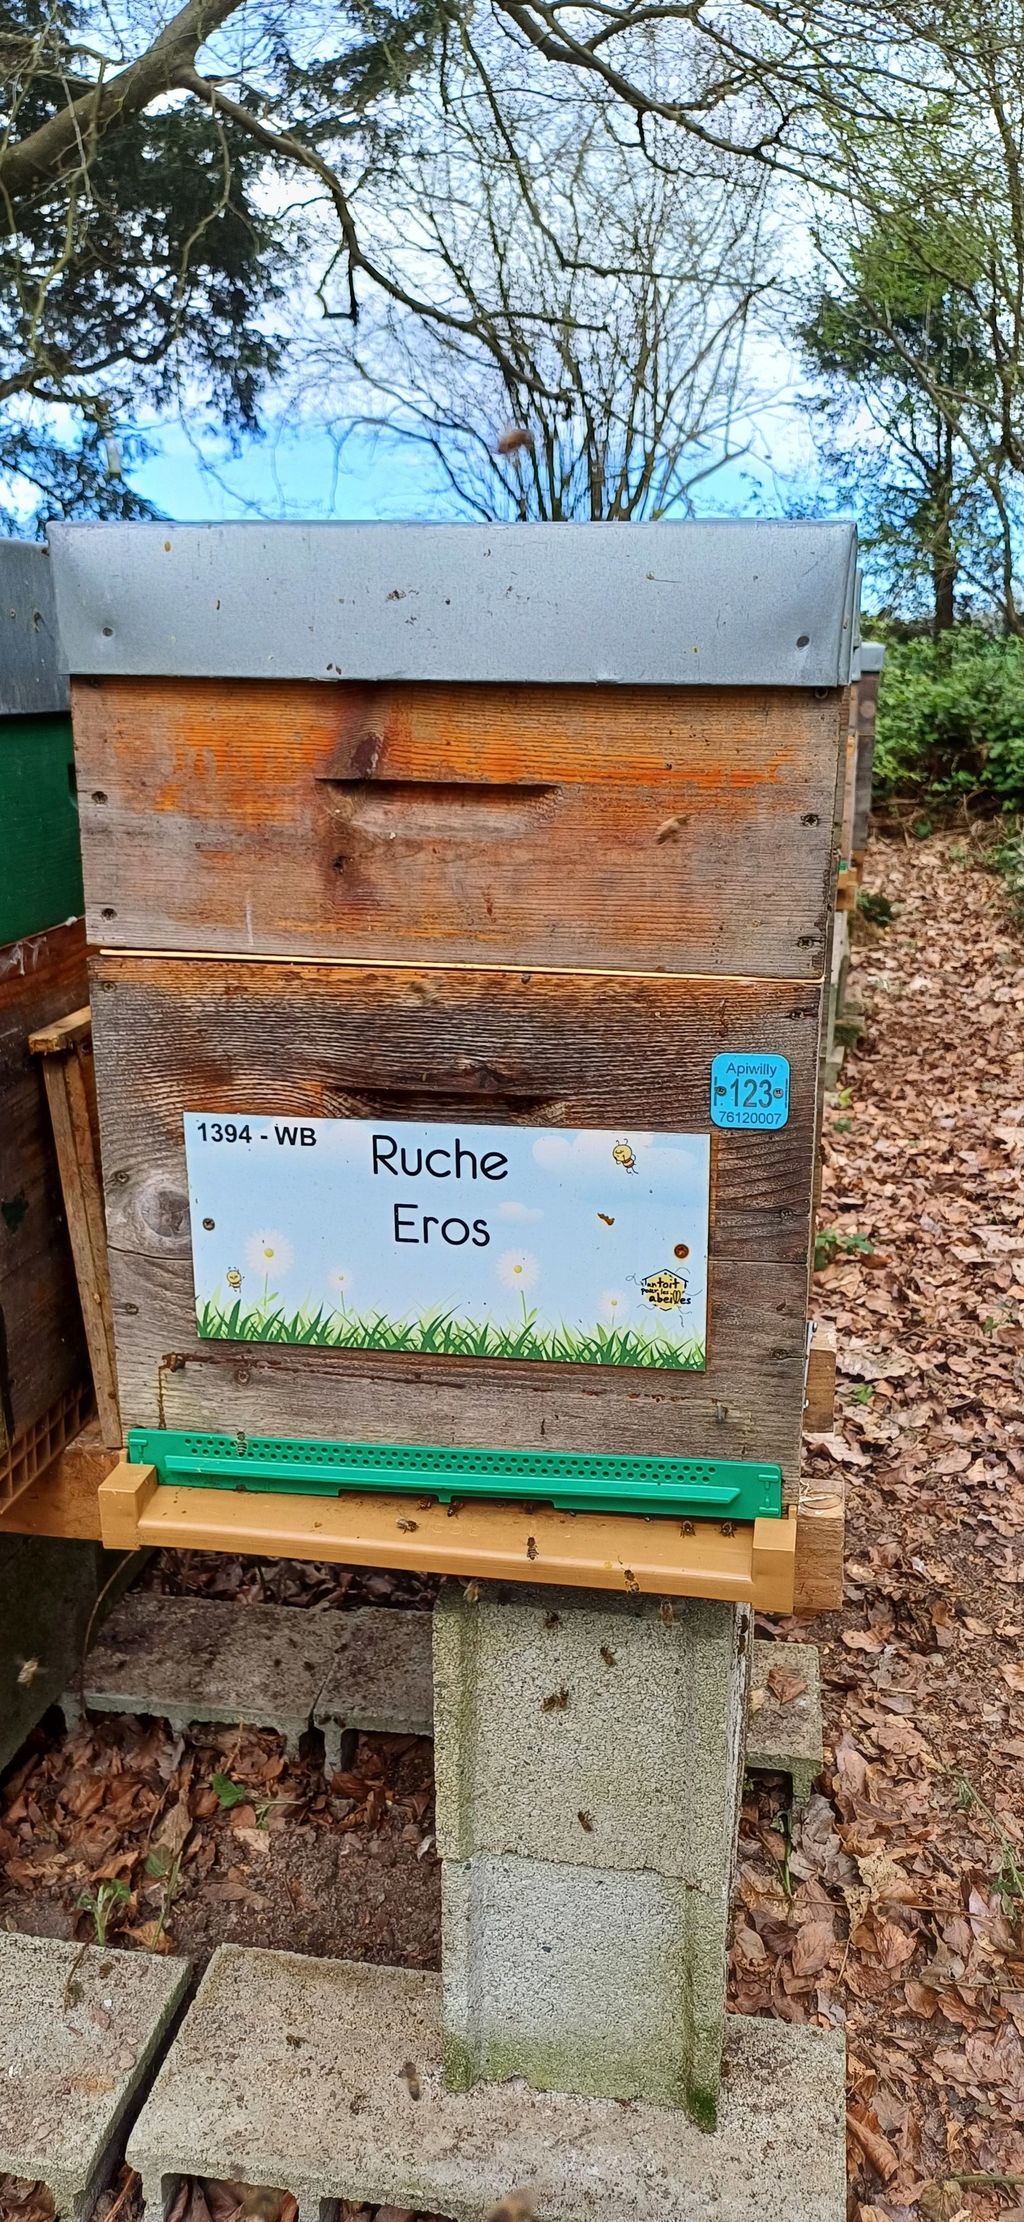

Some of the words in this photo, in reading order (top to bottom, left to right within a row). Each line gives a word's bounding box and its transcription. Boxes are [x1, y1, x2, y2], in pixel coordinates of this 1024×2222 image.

[726, 1062, 778, 1078] Apiwilly
[730, 1078, 773, 1108] 123
[718, 1111, 782, 1125] 76120007
[197, 1122, 253, 1144] 1394
[274, 1126, 317, 1147] WB
[372, 1134, 509, 1181] Ruche
[393, 1203, 491, 1247] Eros
